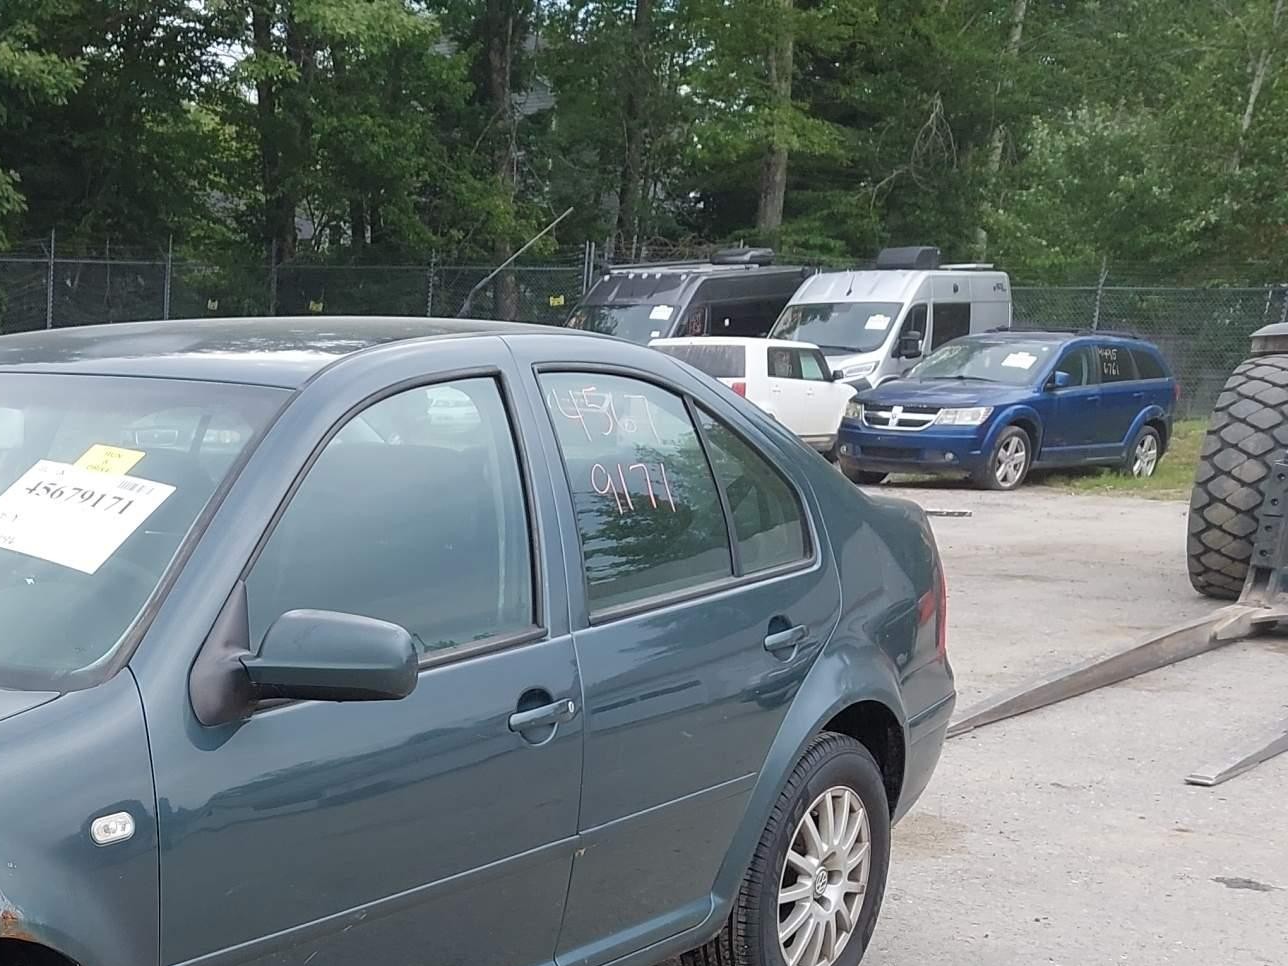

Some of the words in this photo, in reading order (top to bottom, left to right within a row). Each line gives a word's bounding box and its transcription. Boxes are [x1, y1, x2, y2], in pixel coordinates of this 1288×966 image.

[552, 386, 662, 445] 4567
[23, 480, 135, 516] 45679171
[592, 462, 677, 516] 9171
